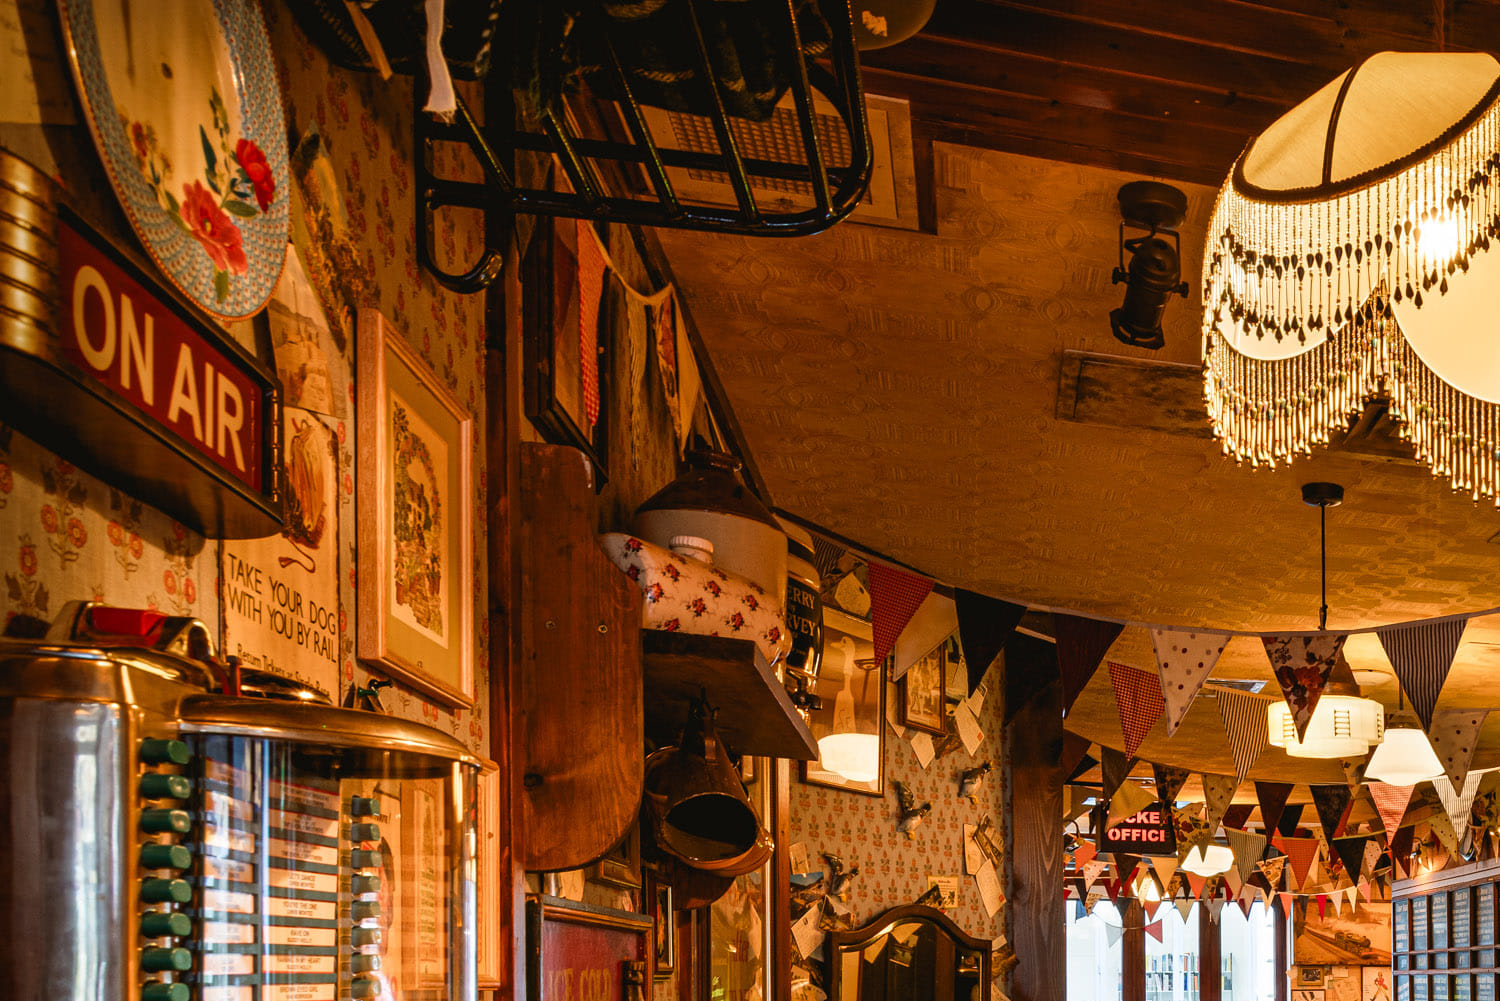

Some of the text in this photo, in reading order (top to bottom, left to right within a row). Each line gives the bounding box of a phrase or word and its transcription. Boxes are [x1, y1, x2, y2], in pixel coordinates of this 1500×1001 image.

[73, 265, 246, 472] ON AIR
[228, 553, 336, 635] TAKE YOUR DOG
[787, 587, 815, 610] ERRY
[228, 583, 336, 663] WITH YOU BY RAIL
[786, 614, 816, 637] RVEY
[1121, 811, 1165, 824] CKE
